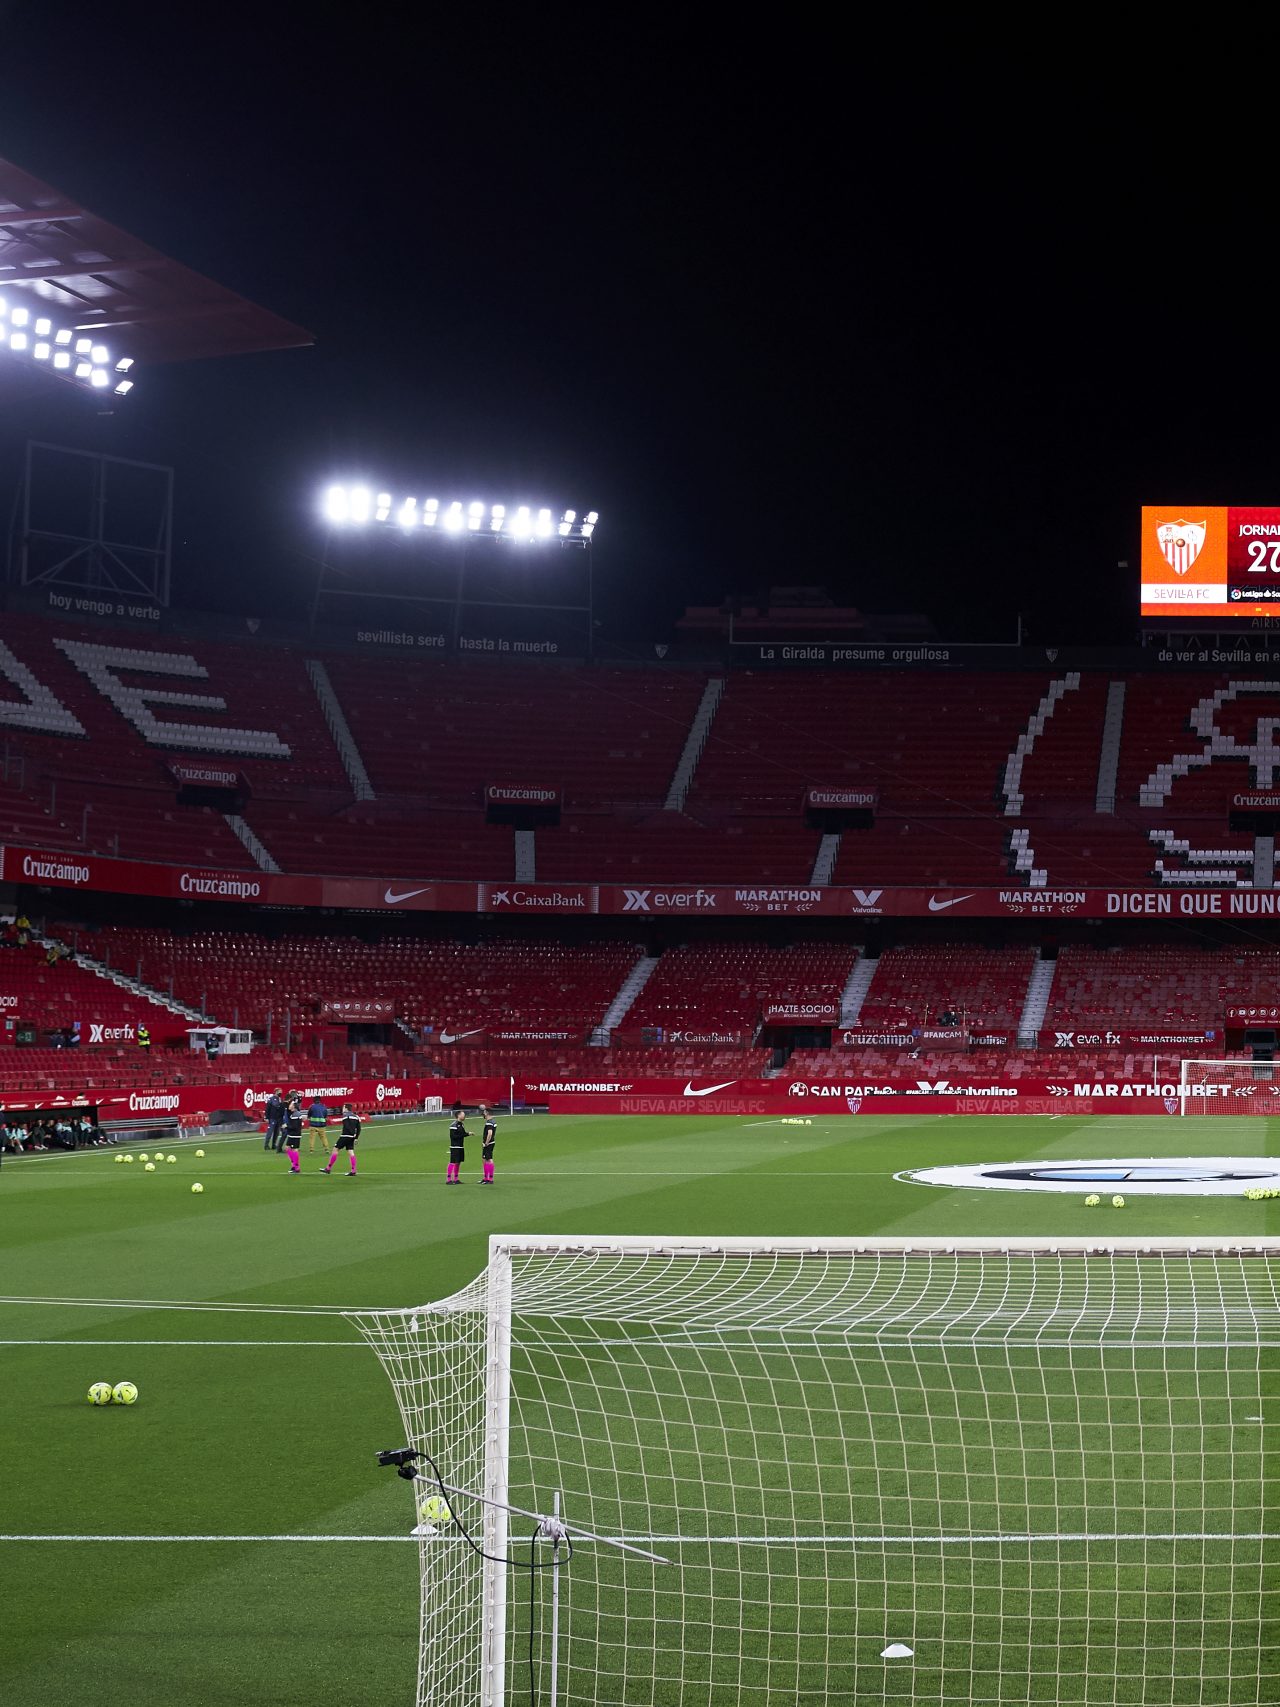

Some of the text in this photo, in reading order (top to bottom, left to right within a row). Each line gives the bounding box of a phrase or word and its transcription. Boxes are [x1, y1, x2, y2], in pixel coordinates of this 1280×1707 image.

[1154, 589, 1210, 599] SEVILLA FC
[50, 592, 160, 620] hoy vengo a verte
[357, 631, 558, 653] sevillista seré hasta la muerte
[760, 647, 950, 662] La Giralda presume orgullosa
[1158, 650, 1174, 662] de
[1176, 652, 1194, 662] ver
[1198, 650, 1208, 662] al
[1212, 650, 1251, 662] Sevilla
[1255, 652, 1269, 662] en
[172, 766, 236, 784] Cruzcampo
[488, 786, 556, 801] Cruzcampo
[810, 790, 874, 805] Cruzcampo
[23, 854, 90, 884] Cruzcampo
[180, 872, 260, 899] Cruzcampo
[513, 891, 584, 906] CaixaBank
[654, 890, 716, 907] everfx
[736, 890, 820, 902] MARATHON
[1000, 892, 1086, 903] MARATHON
[1107, 894, 1171, 912] DICEN
[1180, 894, 1222, 914] QUE
[768, 1004, 834, 1014] ¡HAZTE SOCIO!
[104, 1024, 134, 1039] everfx
[502, 1032, 568, 1040] MARATHONBET
[684, 1031, 734, 1042] CaixaBank
[844, 1031, 914, 1046] Cruzcampo
[305, 1088, 347, 1097] MARATHONBET
[384, 1086, 402, 1097] LaLiga
[540, 1084, 620, 1092] MARATHONBET
[810, 1086, 840, 1096] SAN
[1074, 1084, 1232, 1096] MARATHONBET
[130, 1092, 180, 1112] Cruzcampo
[620, 1100, 766, 1113] NUEVA APP SEVILLA FC
[956, 1100, 1092, 1112] NEW APP SEVILLA FC
